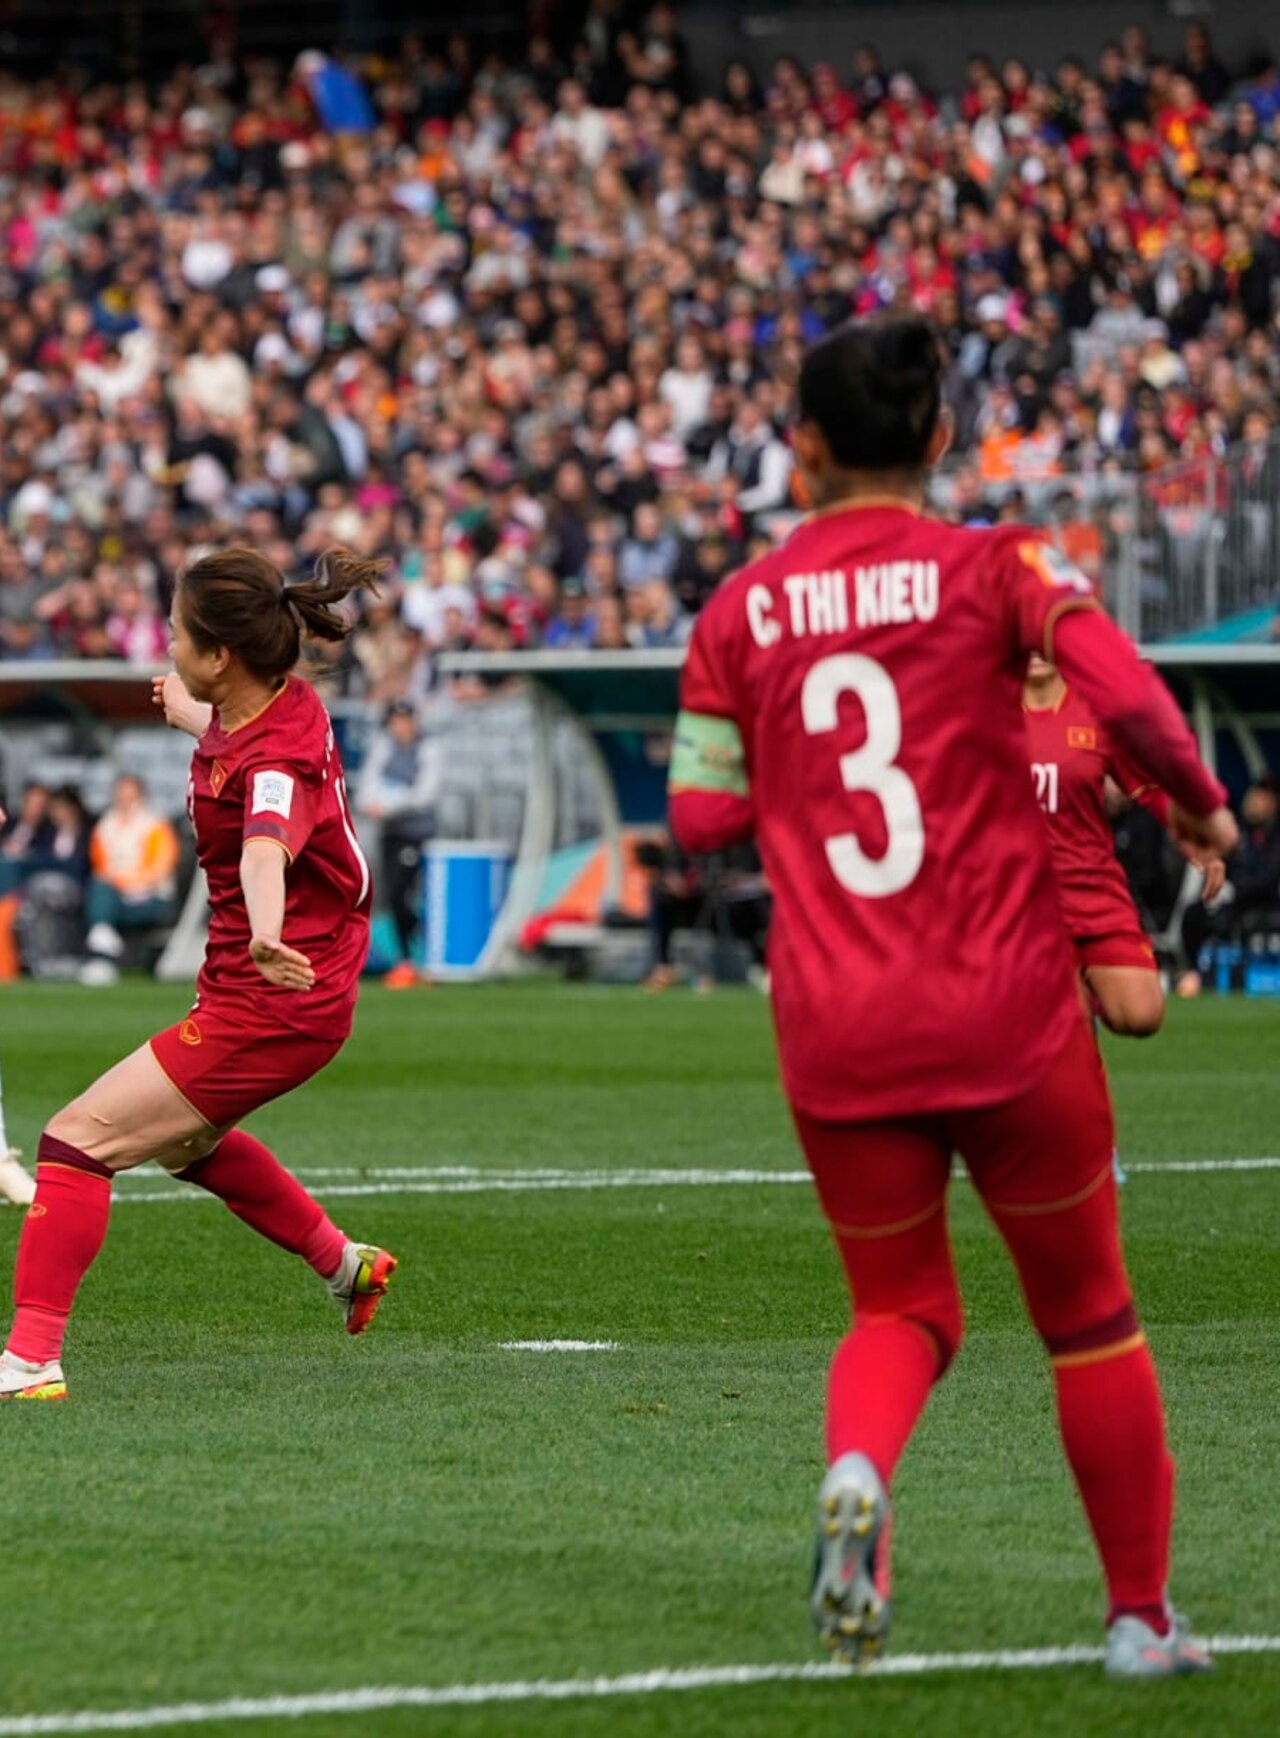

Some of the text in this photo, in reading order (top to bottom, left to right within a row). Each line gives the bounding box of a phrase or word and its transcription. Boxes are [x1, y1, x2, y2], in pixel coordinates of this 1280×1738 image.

[783, 569, 849, 638] THI
[854, 559, 939, 629] KIEU
[801, 652, 926, 898] 3
